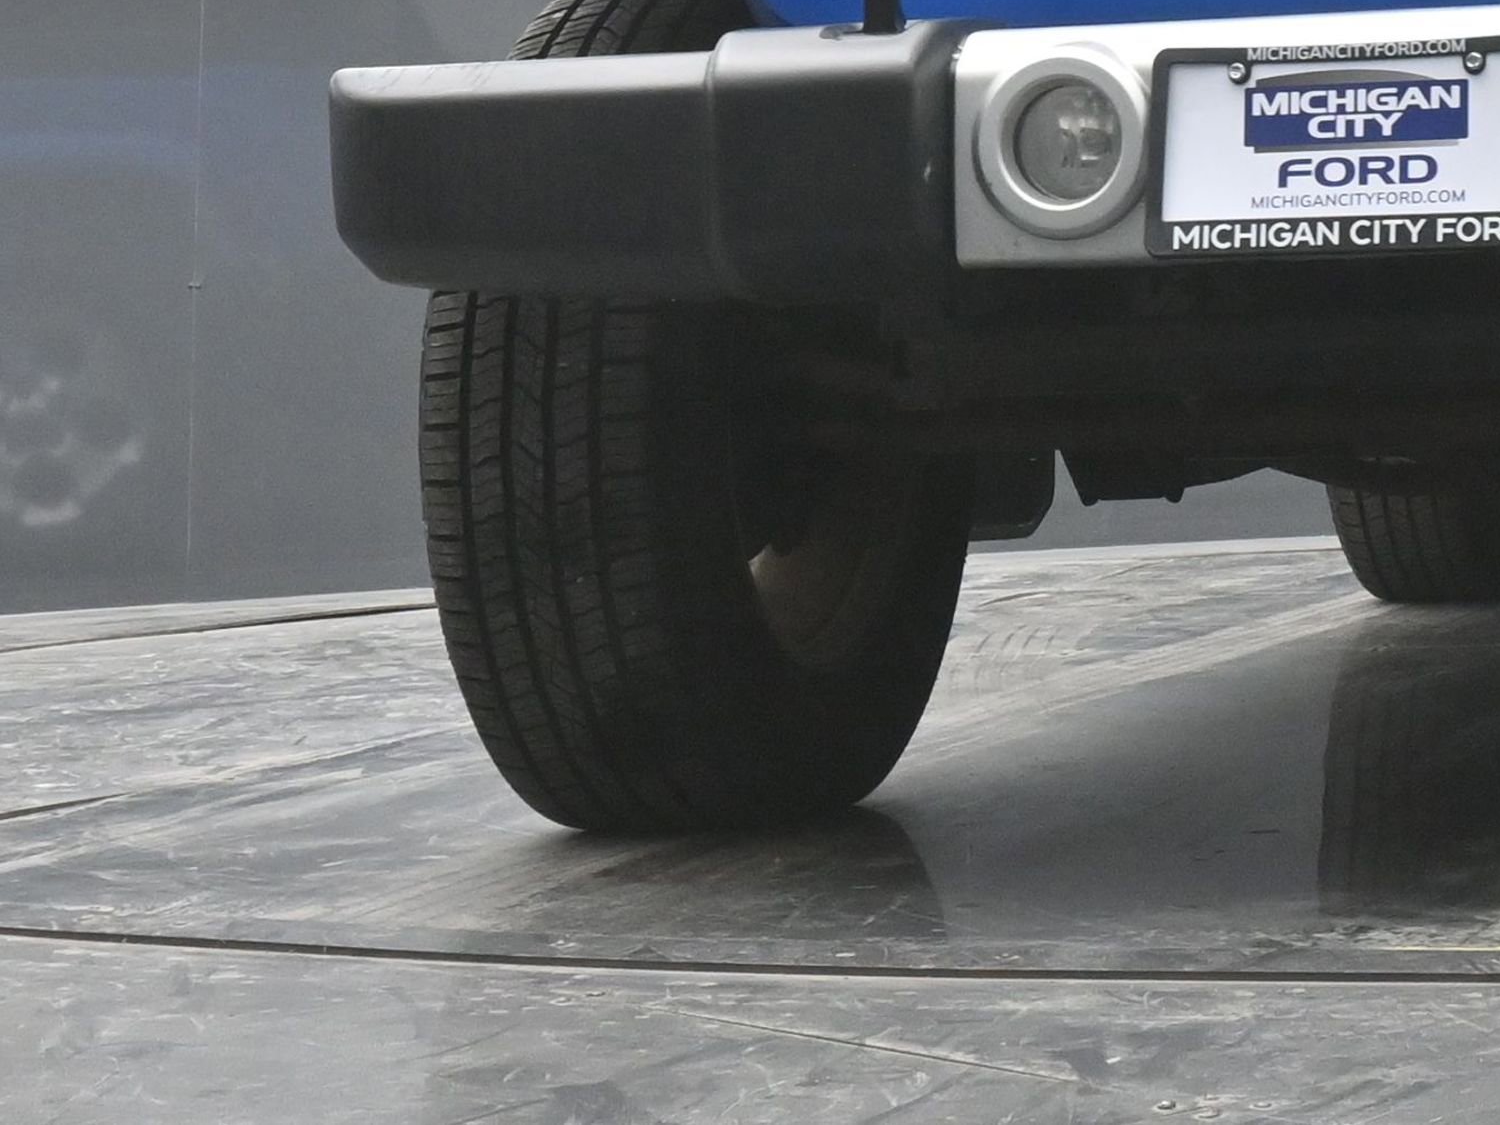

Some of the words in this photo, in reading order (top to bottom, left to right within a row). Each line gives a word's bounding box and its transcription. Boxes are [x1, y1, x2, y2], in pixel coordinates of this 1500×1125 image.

[1246, 38, 1466, 62] MICHIGANCITYFORD.COM
[1251, 85, 1461, 116] MICHIGAN
[1307, 112, 1402, 139] CITY
[1277, 154, 1438, 188] FORD
[1250, 189, 1466, 209] MICHIGANCITYFORD.COM
[1172, 221, 1340, 250] MICHIGAN
[1349, 218, 1426, 245] CITY
